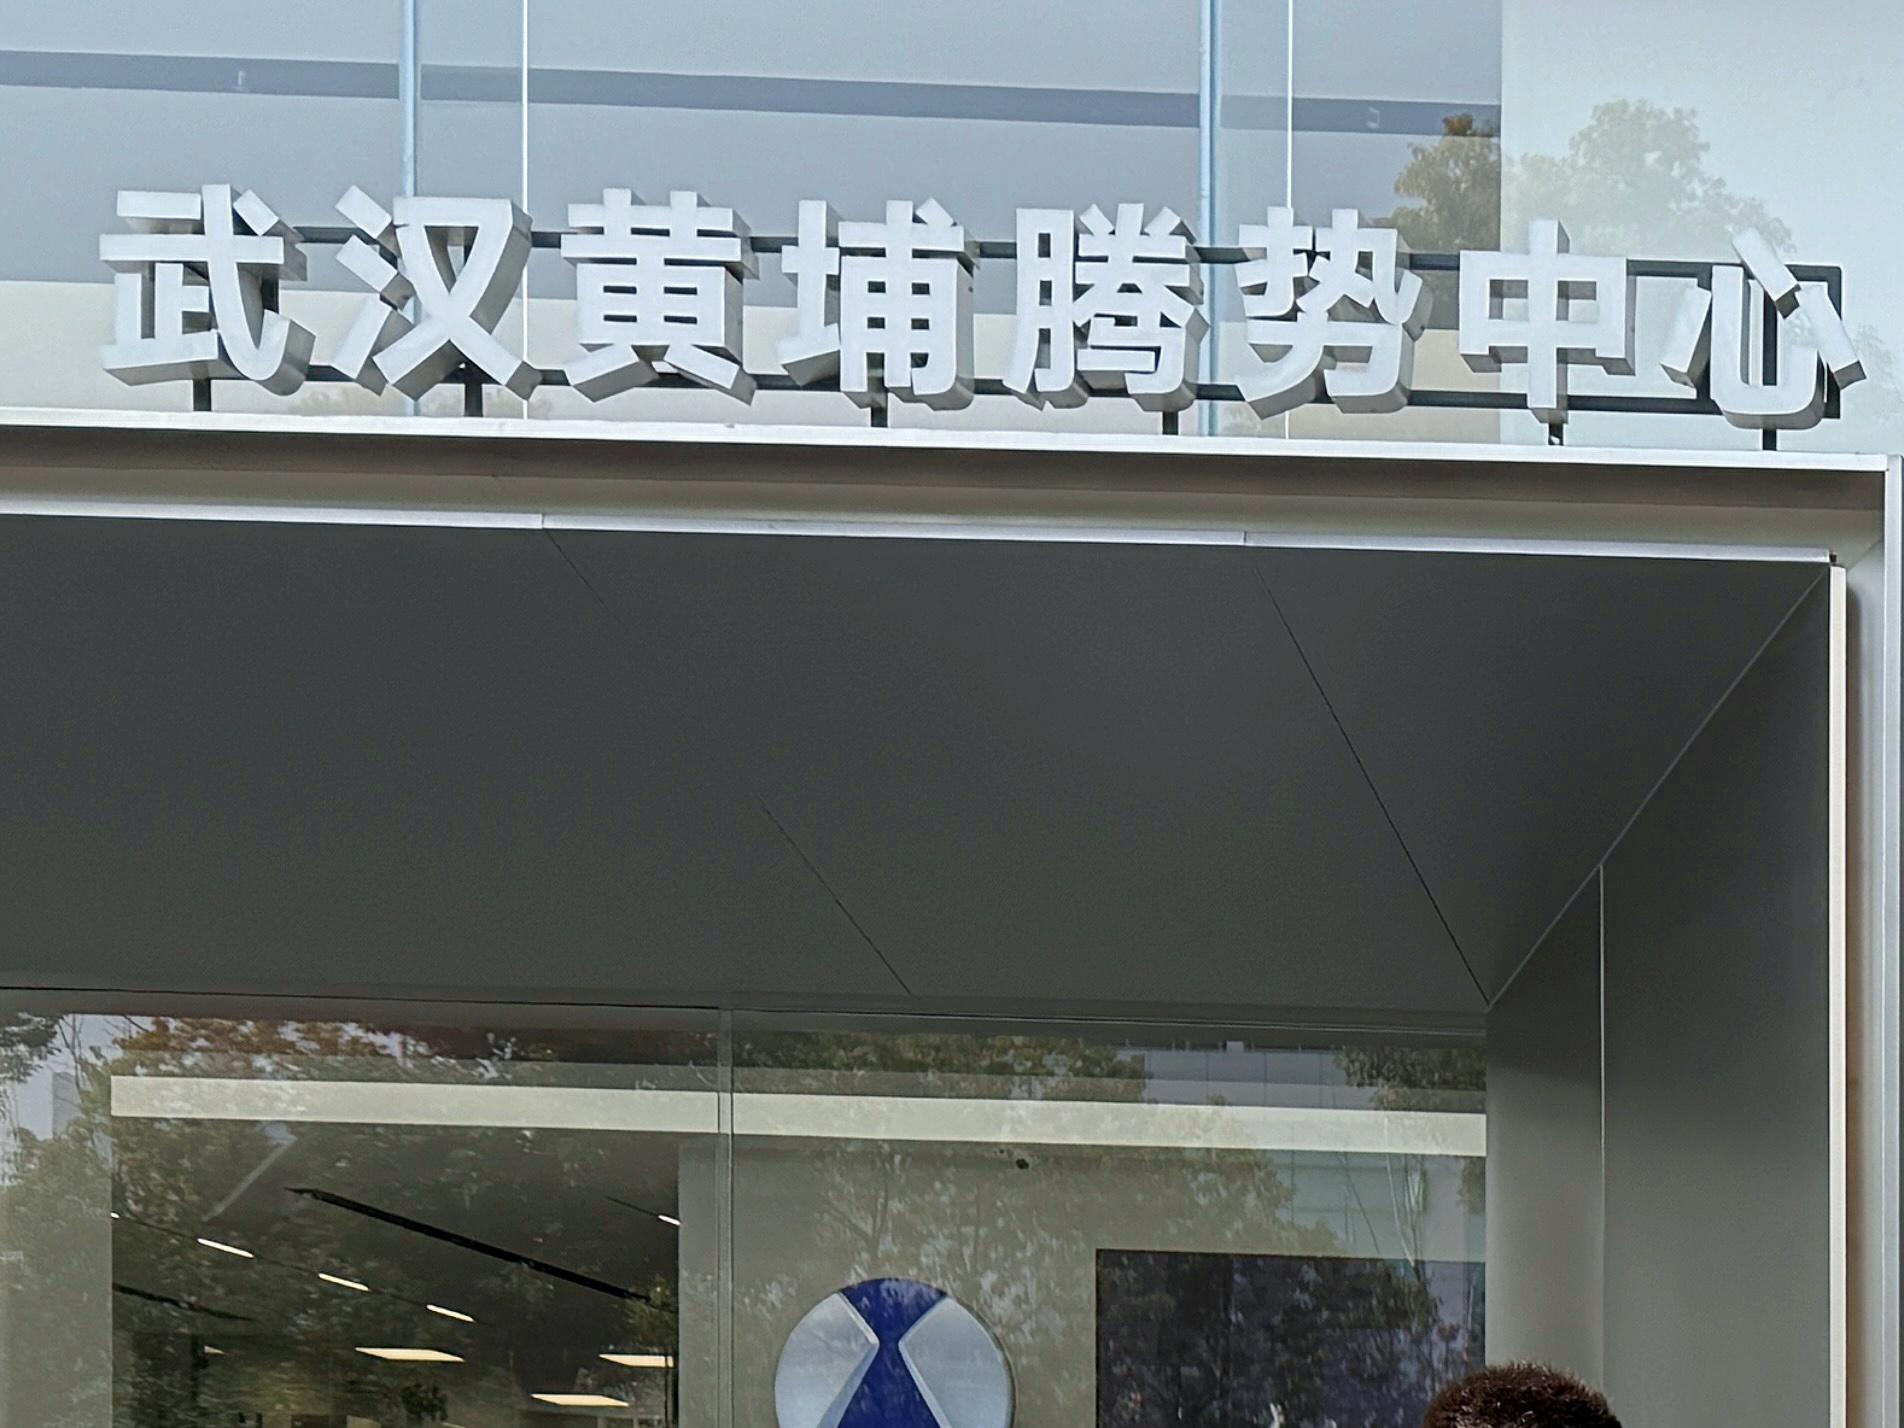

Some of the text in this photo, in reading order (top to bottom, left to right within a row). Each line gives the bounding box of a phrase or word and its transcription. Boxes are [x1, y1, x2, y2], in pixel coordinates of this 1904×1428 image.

[98, 182, 1868, 428] 武汉黄埔腾势中心
